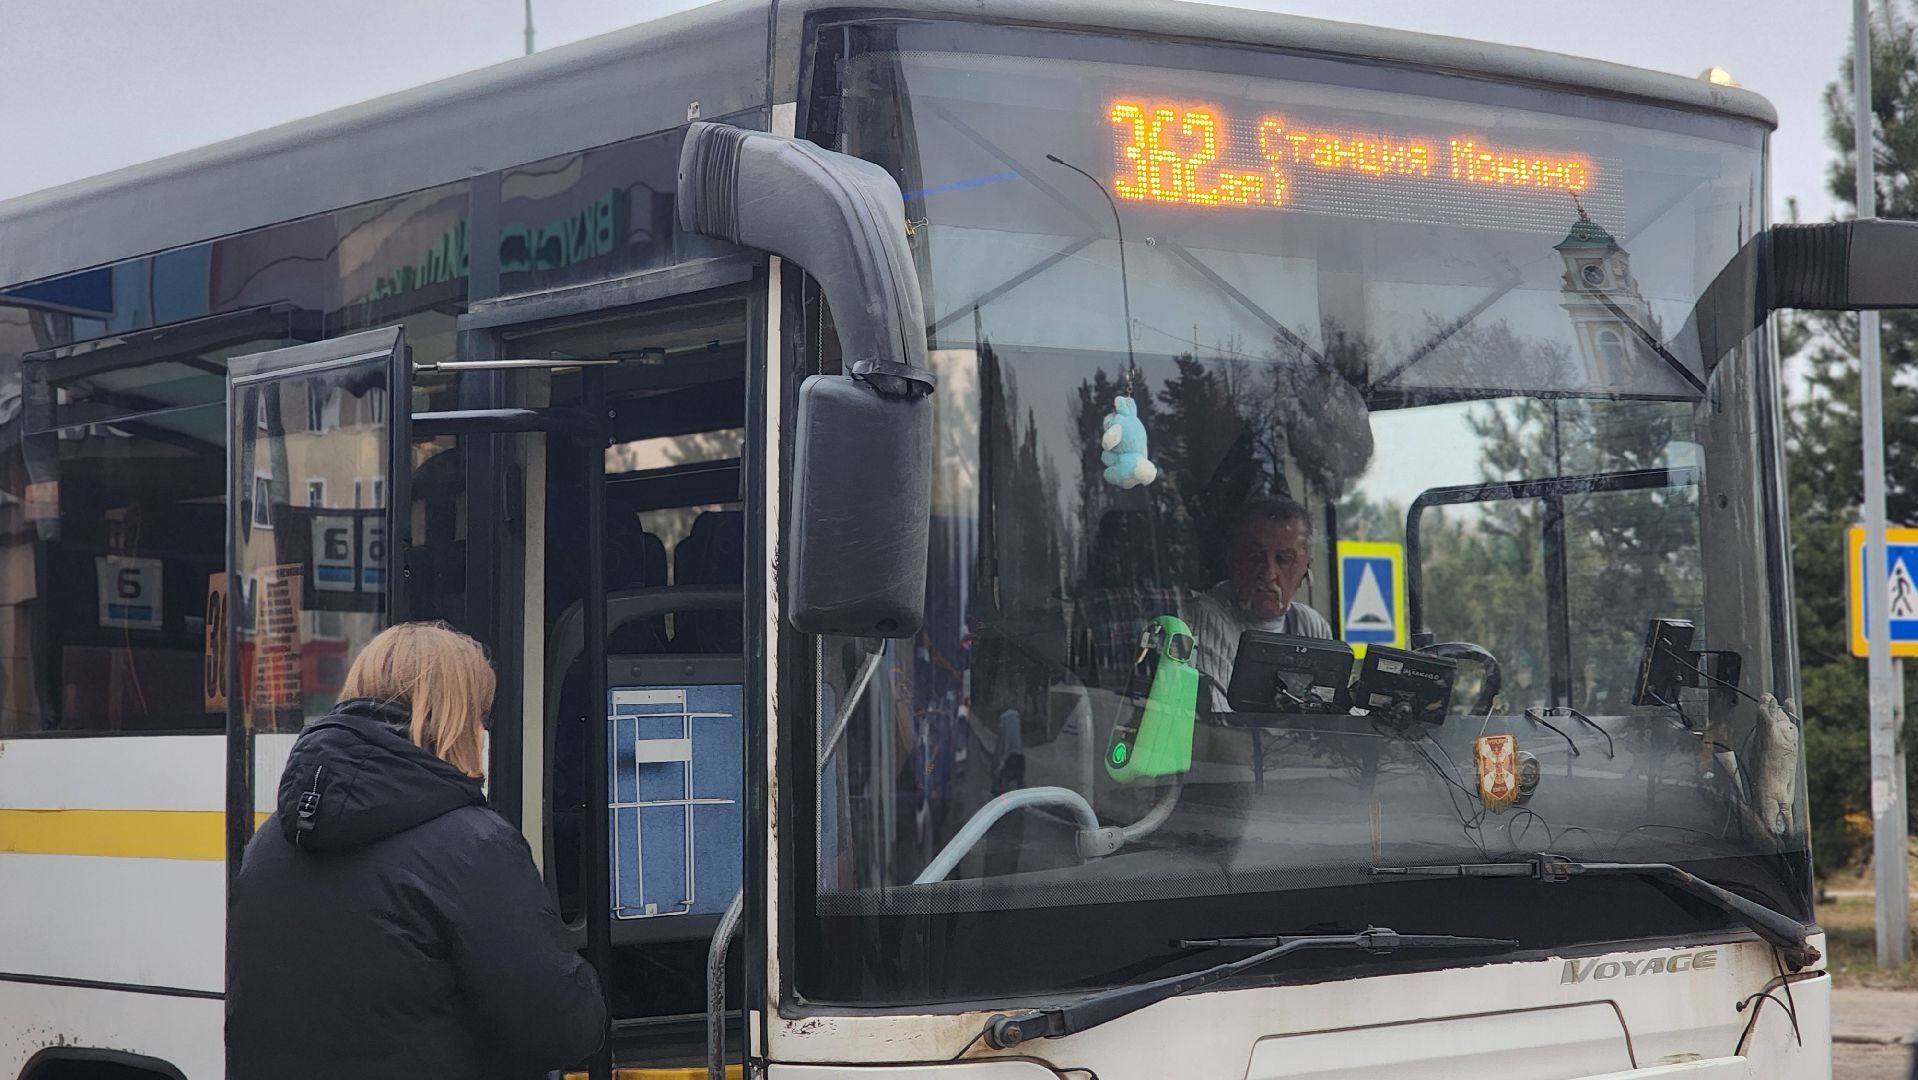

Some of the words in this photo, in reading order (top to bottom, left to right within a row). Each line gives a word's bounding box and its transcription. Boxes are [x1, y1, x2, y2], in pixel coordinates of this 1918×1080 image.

[1111, 103, 1219, 205] 362
[1259, 120, 1429, 176] Станция
[1450, 139, 1586, 190] Монино
[1560, 950, 1718, 985] VOYAGE
